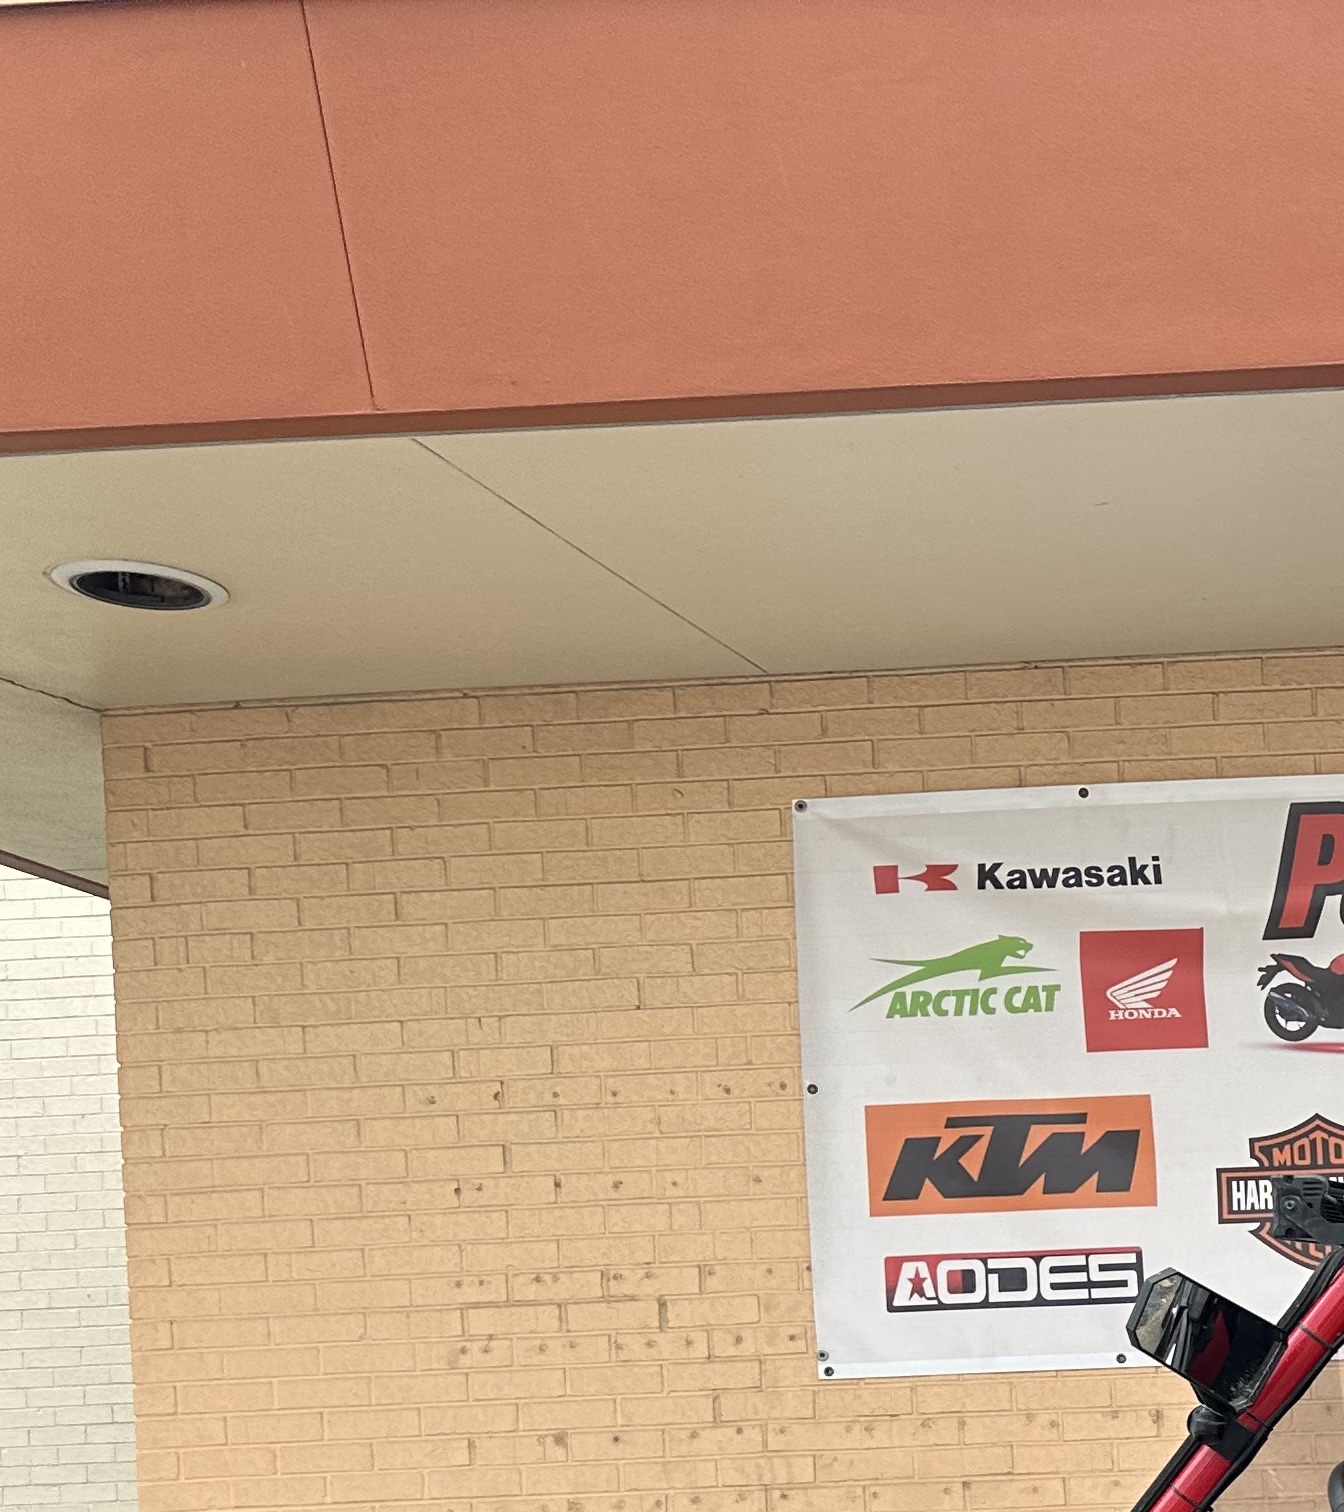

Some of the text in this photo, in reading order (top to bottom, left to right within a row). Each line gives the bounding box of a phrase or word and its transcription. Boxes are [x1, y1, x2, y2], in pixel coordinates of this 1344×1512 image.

[976, 855, 1163, 891] Kawasaki
[885, 983, 1061, 1020] ARCTIC CAT
[1107, 1005, 1183, 1021] HONDA
[882, 1112, 1141, 1201] KTM
[892, 1256, 1138, 1306] AODES
